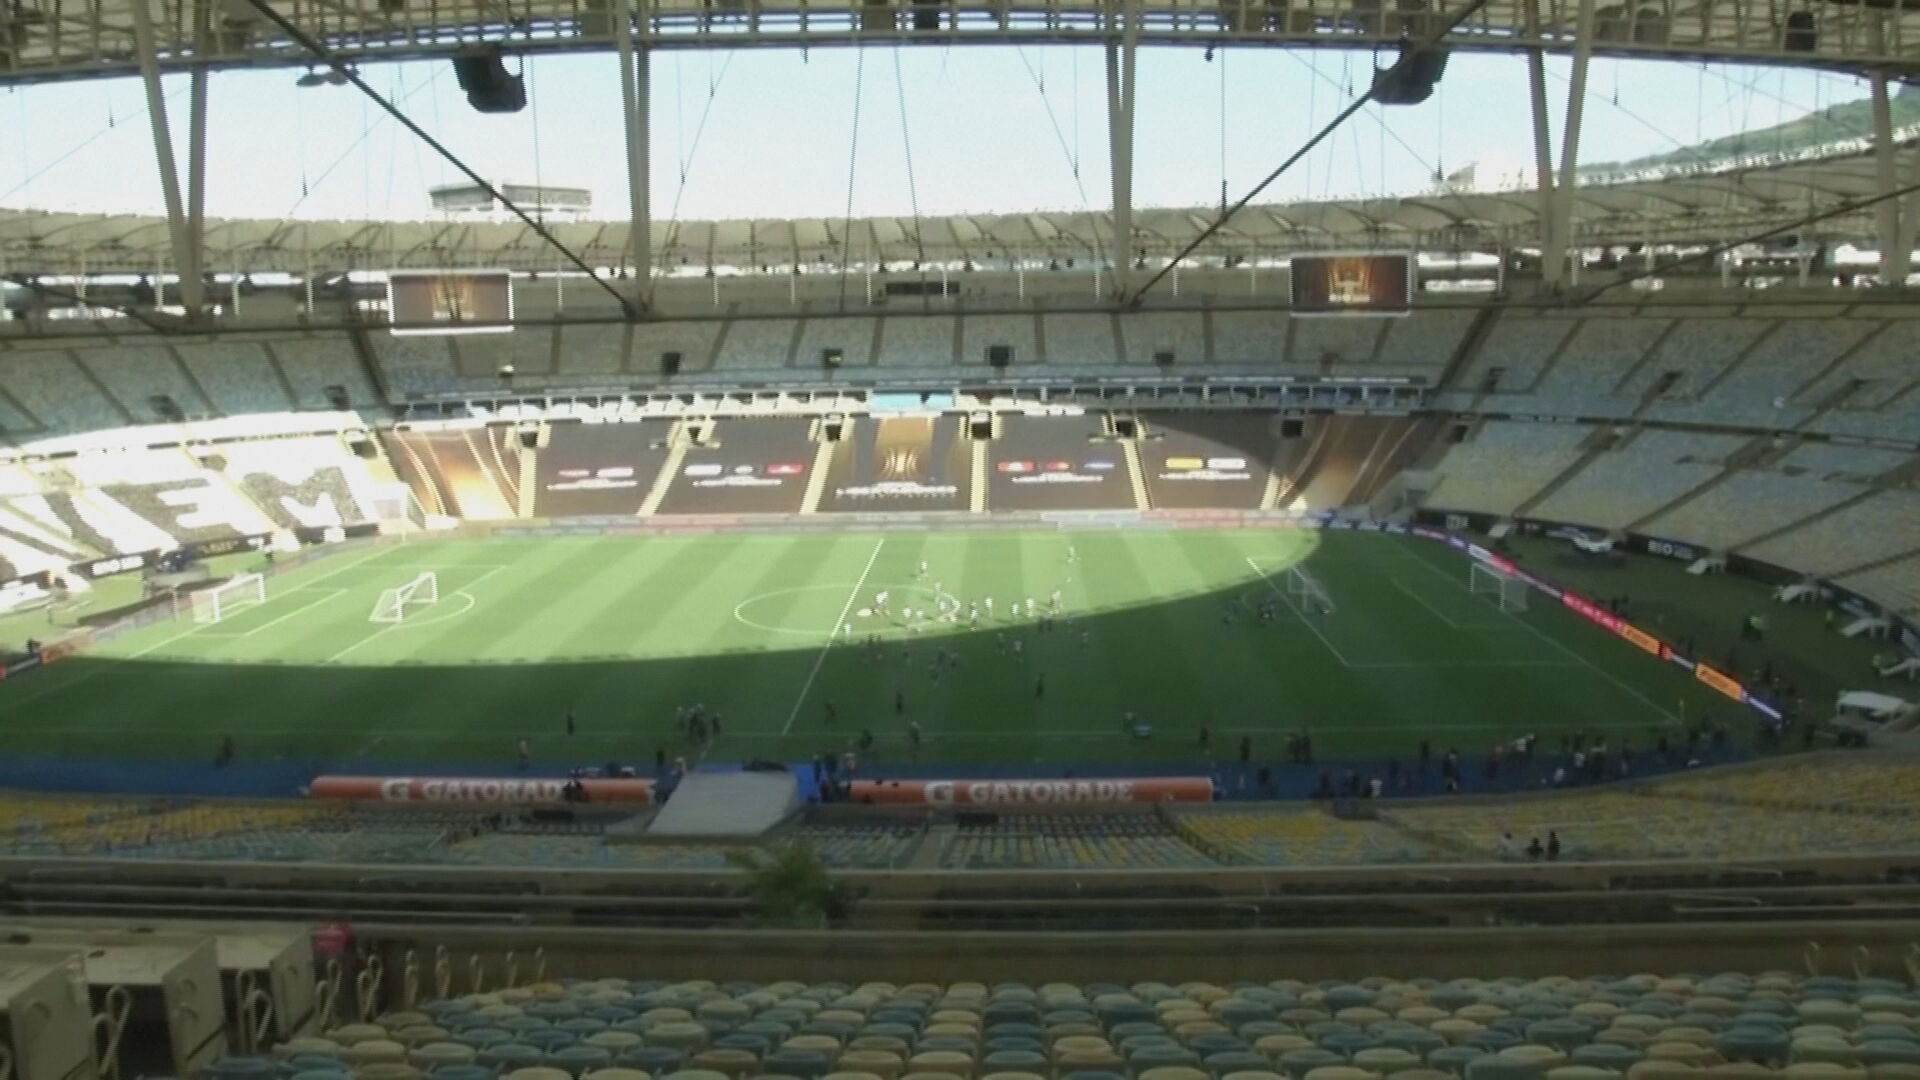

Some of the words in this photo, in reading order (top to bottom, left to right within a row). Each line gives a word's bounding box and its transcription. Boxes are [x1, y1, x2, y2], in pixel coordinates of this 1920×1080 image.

[382, 776, 410, 802] G
[422, 778, 570, 801] GATORAD
[924, 780, 954, 805] G
[968, 779, 1134, 803] GATORADE
